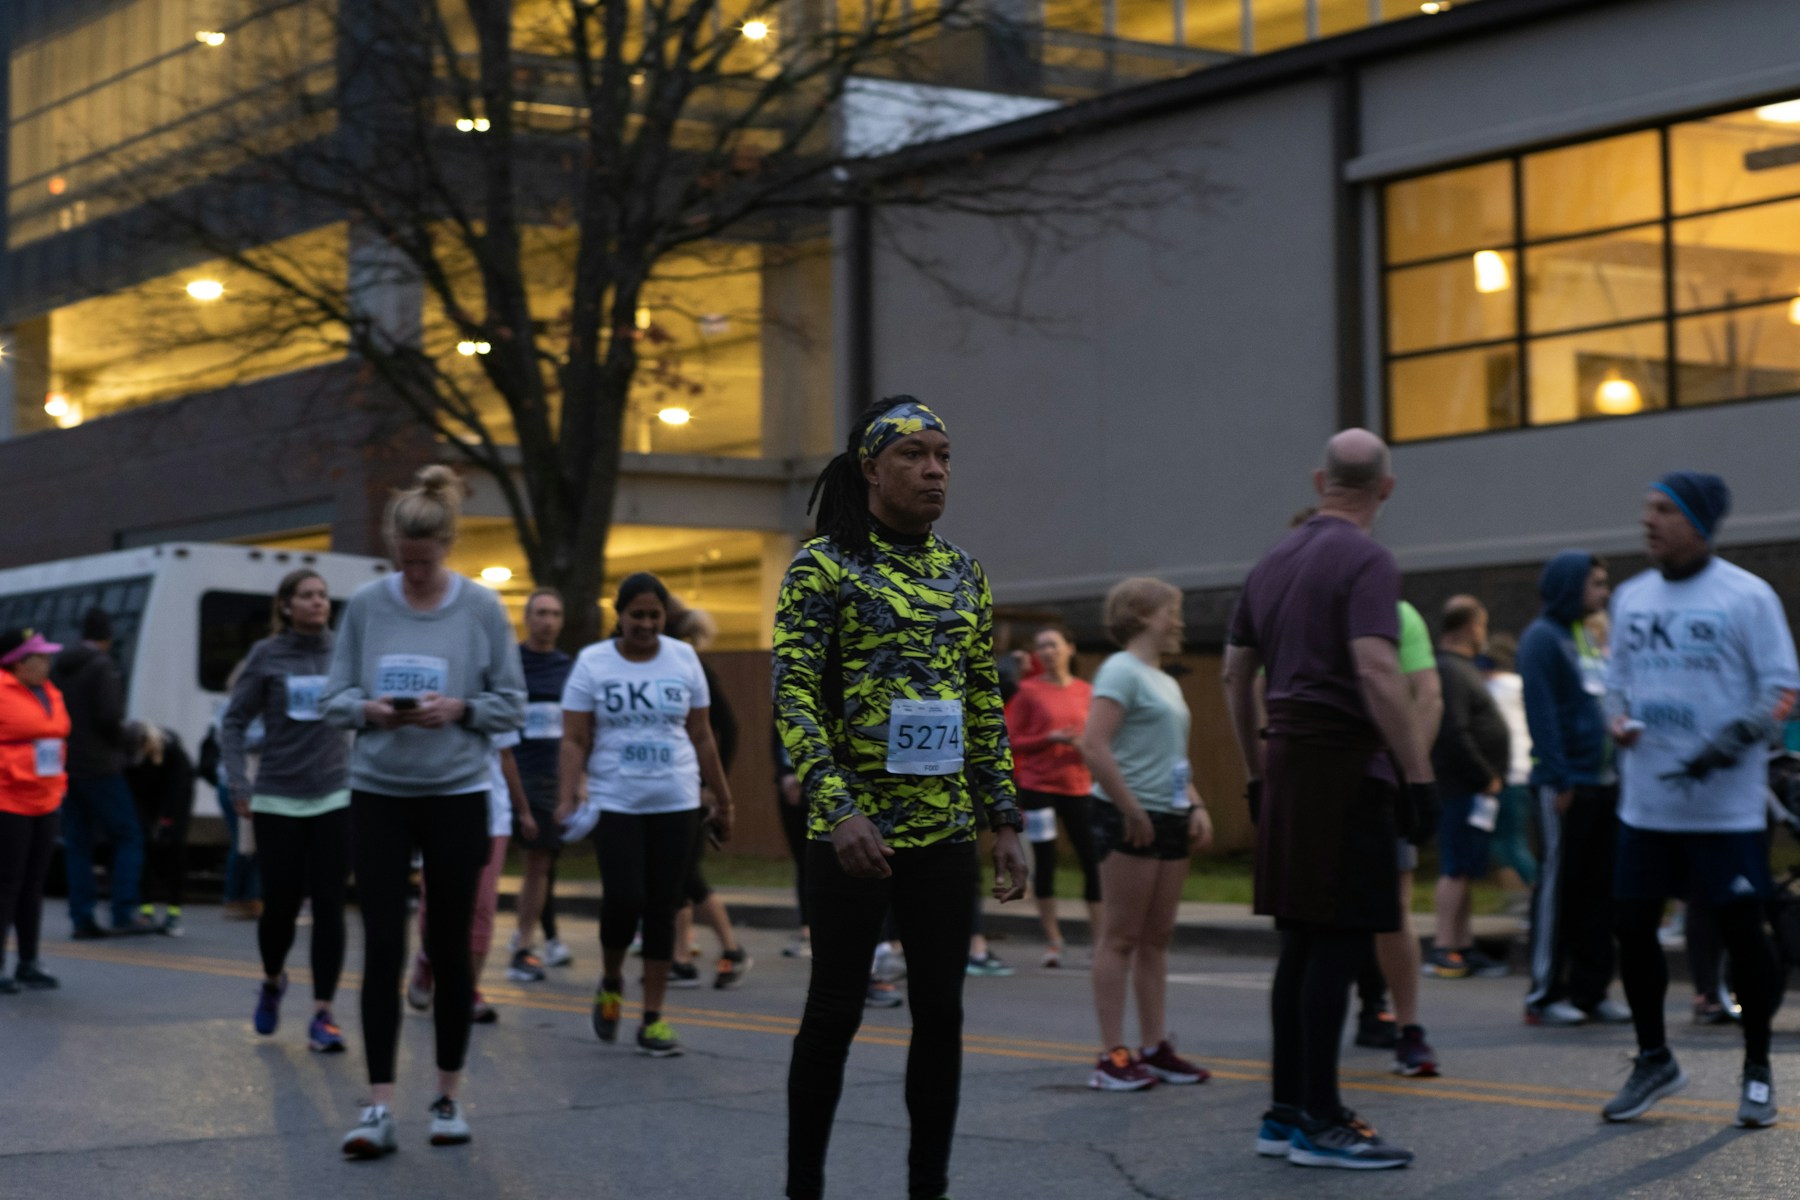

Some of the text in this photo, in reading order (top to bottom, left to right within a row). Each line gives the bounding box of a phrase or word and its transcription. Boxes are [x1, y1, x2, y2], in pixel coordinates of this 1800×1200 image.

[1629, 611, 1676, 652] 5K
[604, 682, 654, 713] 5K
[896, 724, 960, 750] 5274
